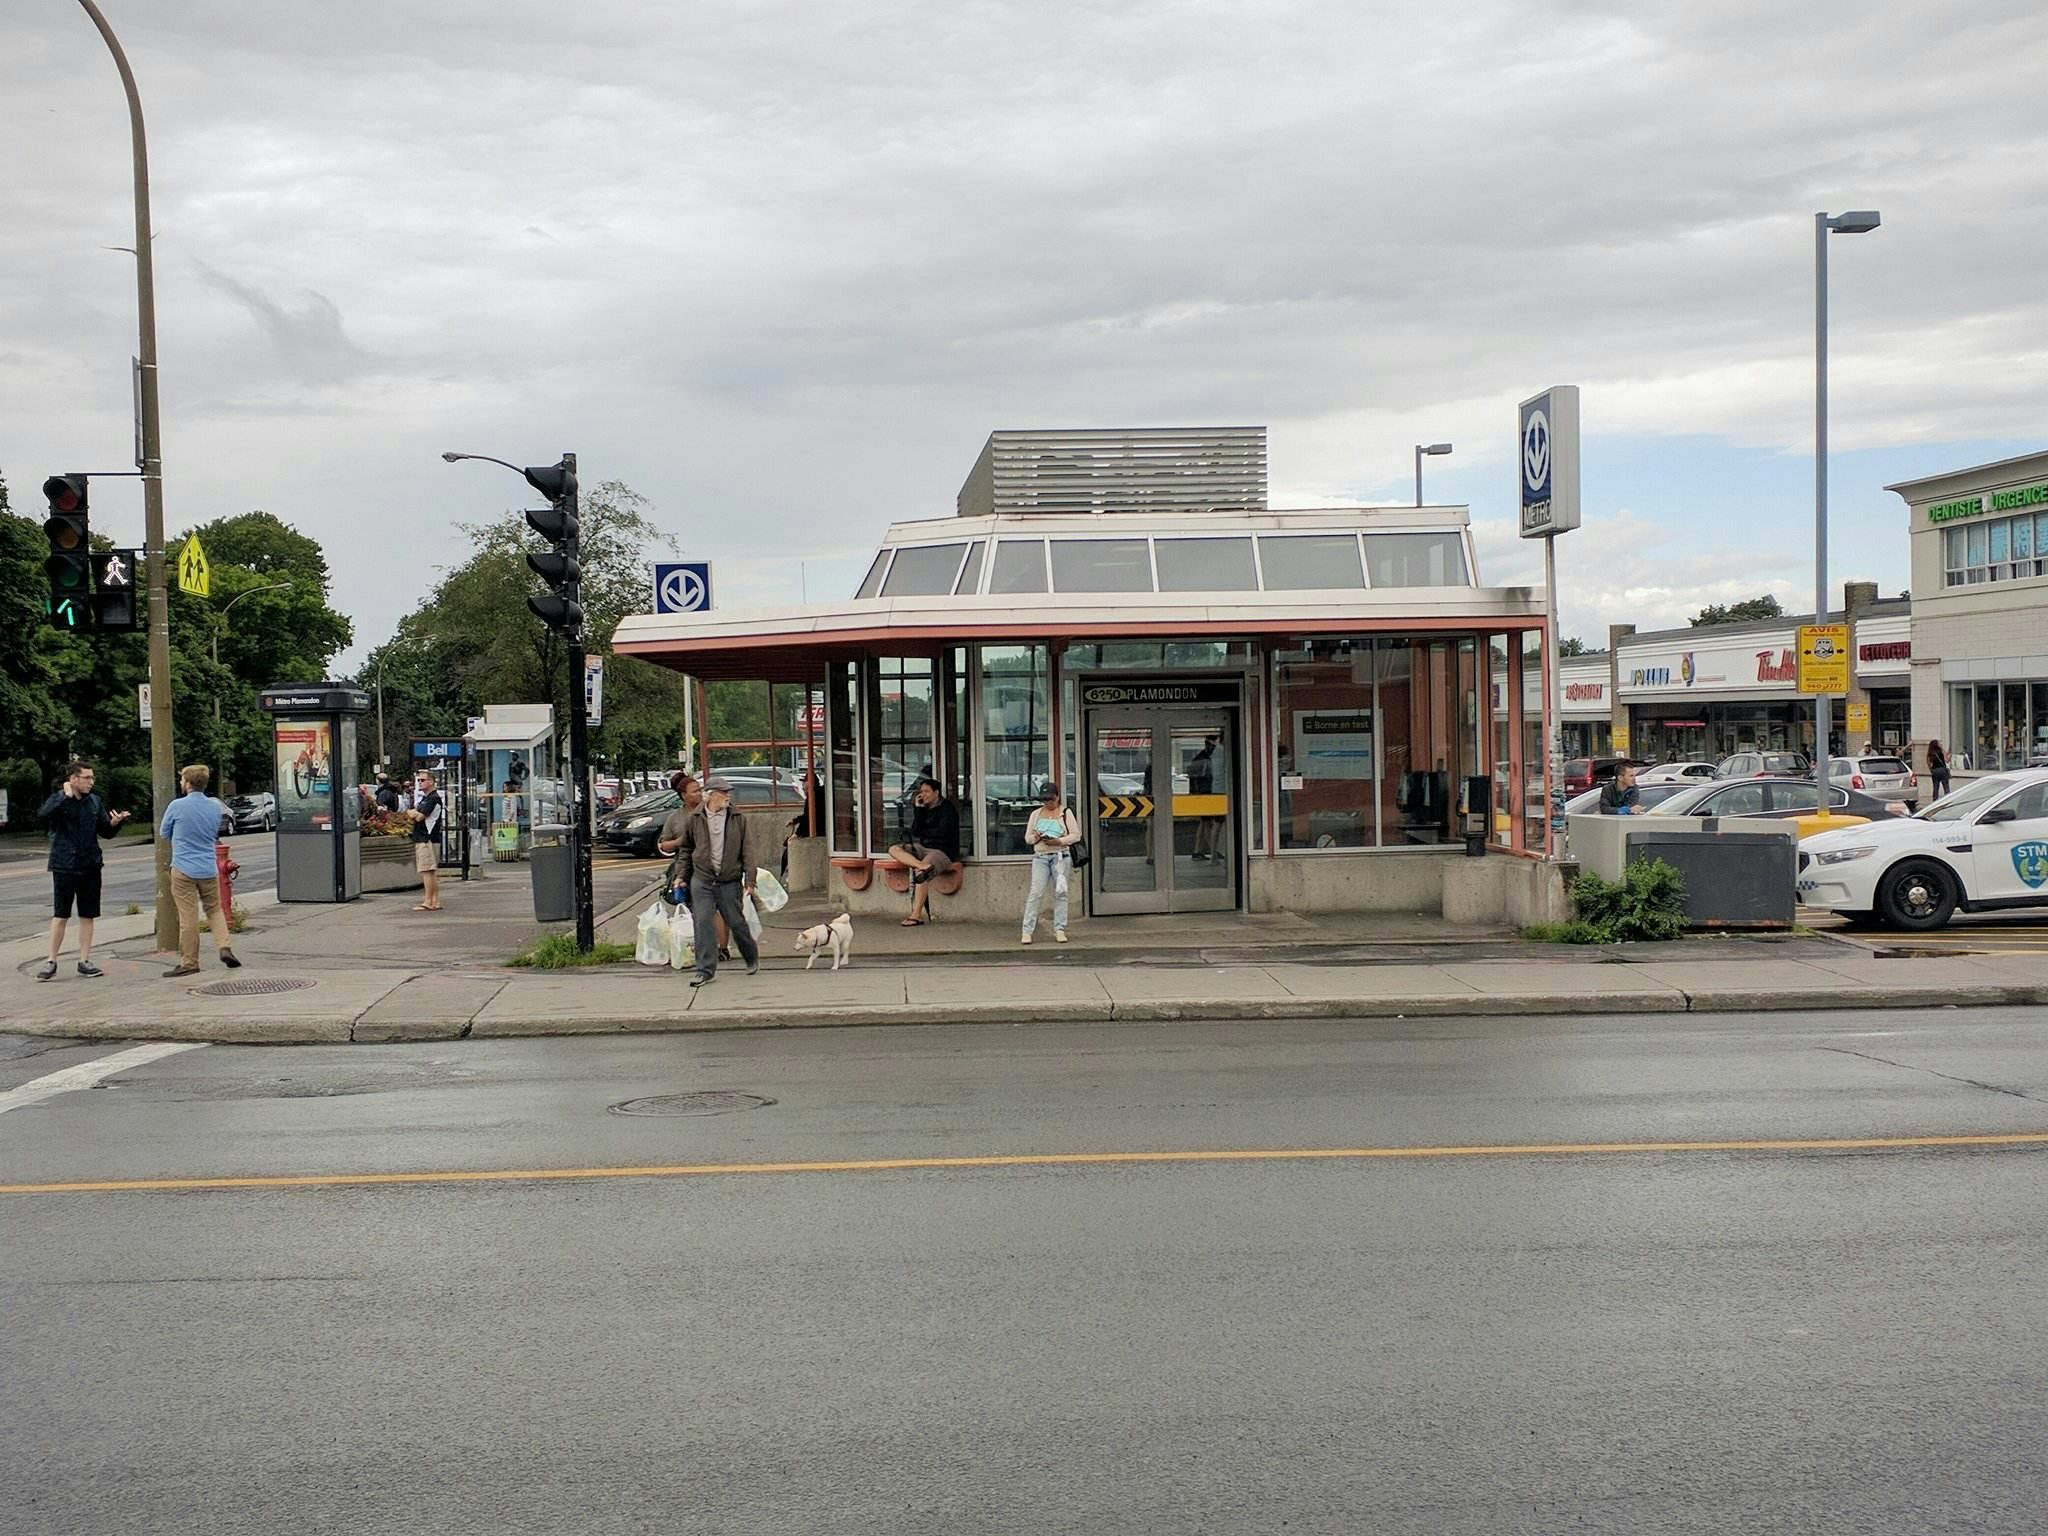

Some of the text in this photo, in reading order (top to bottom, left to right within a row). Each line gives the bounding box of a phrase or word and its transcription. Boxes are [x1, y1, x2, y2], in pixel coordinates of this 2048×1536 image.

[1928, 498, 1983, 521] DENTISTE
[1127, 687, 1198, 700] PLAMONDON
[427, 743, 448, 756] Bell
[2018, 845, 2047, 858] STM
